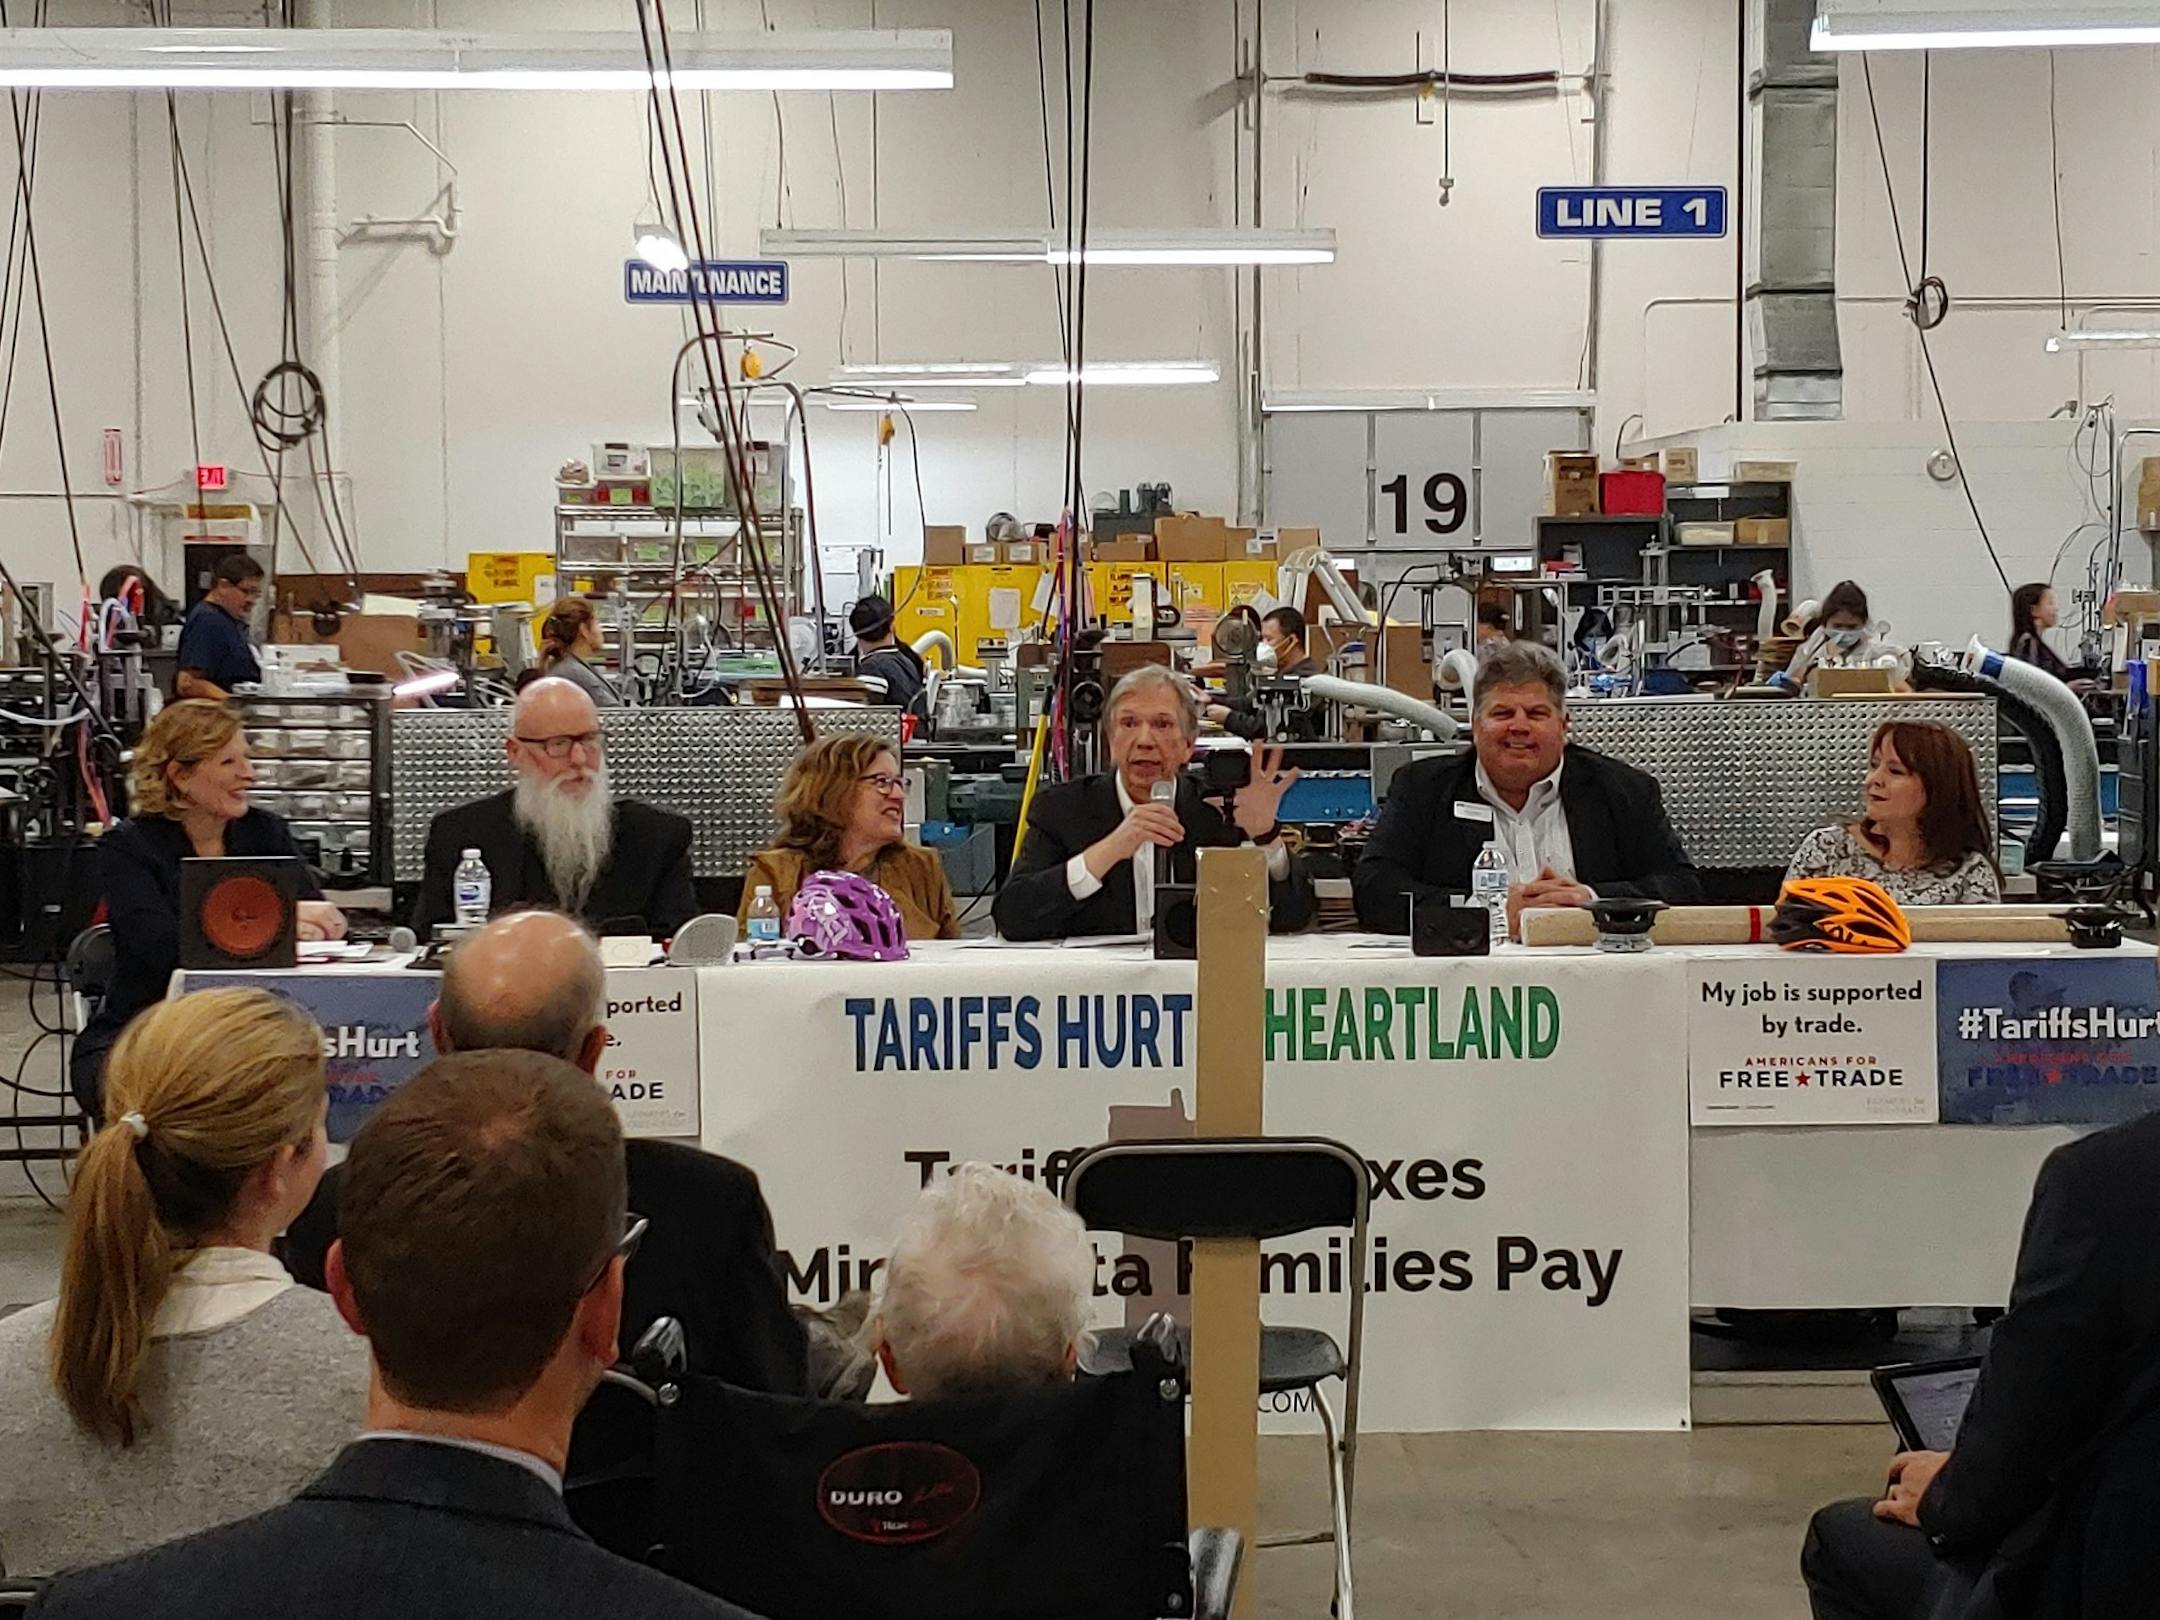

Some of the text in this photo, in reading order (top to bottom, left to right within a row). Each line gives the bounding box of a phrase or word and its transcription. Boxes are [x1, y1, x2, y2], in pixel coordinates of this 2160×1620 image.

[1557, 198, 1707, 227] LINE 1
[1381, 472, 1467, 534] 19
[607, 992, 682, 1018] ported
[1702, 980, 1922, 1006] My job is supported
[845, 986, 1560, 1072] TARIFFS HURT HEARTLAND
[1762, 1013, 1862, 1038] by trade.
[322, 1026, 420, 1058] sHurt
[1745, 1056, 1877, 1066] AMERICANS FOR
[612, 1082, 664, 1100] ADE
[1720, 1069, 1903, 1088] FREE TRADE
[1365, 1158, 1486, 1201] xes
[1177, 1236, 1473, 1293] Fmiies
[1497, 1237, 1622, 1307] Pay
[1258, 1391, 1315, 1413] COM
[830, 1490, 903, 1506] DURO
